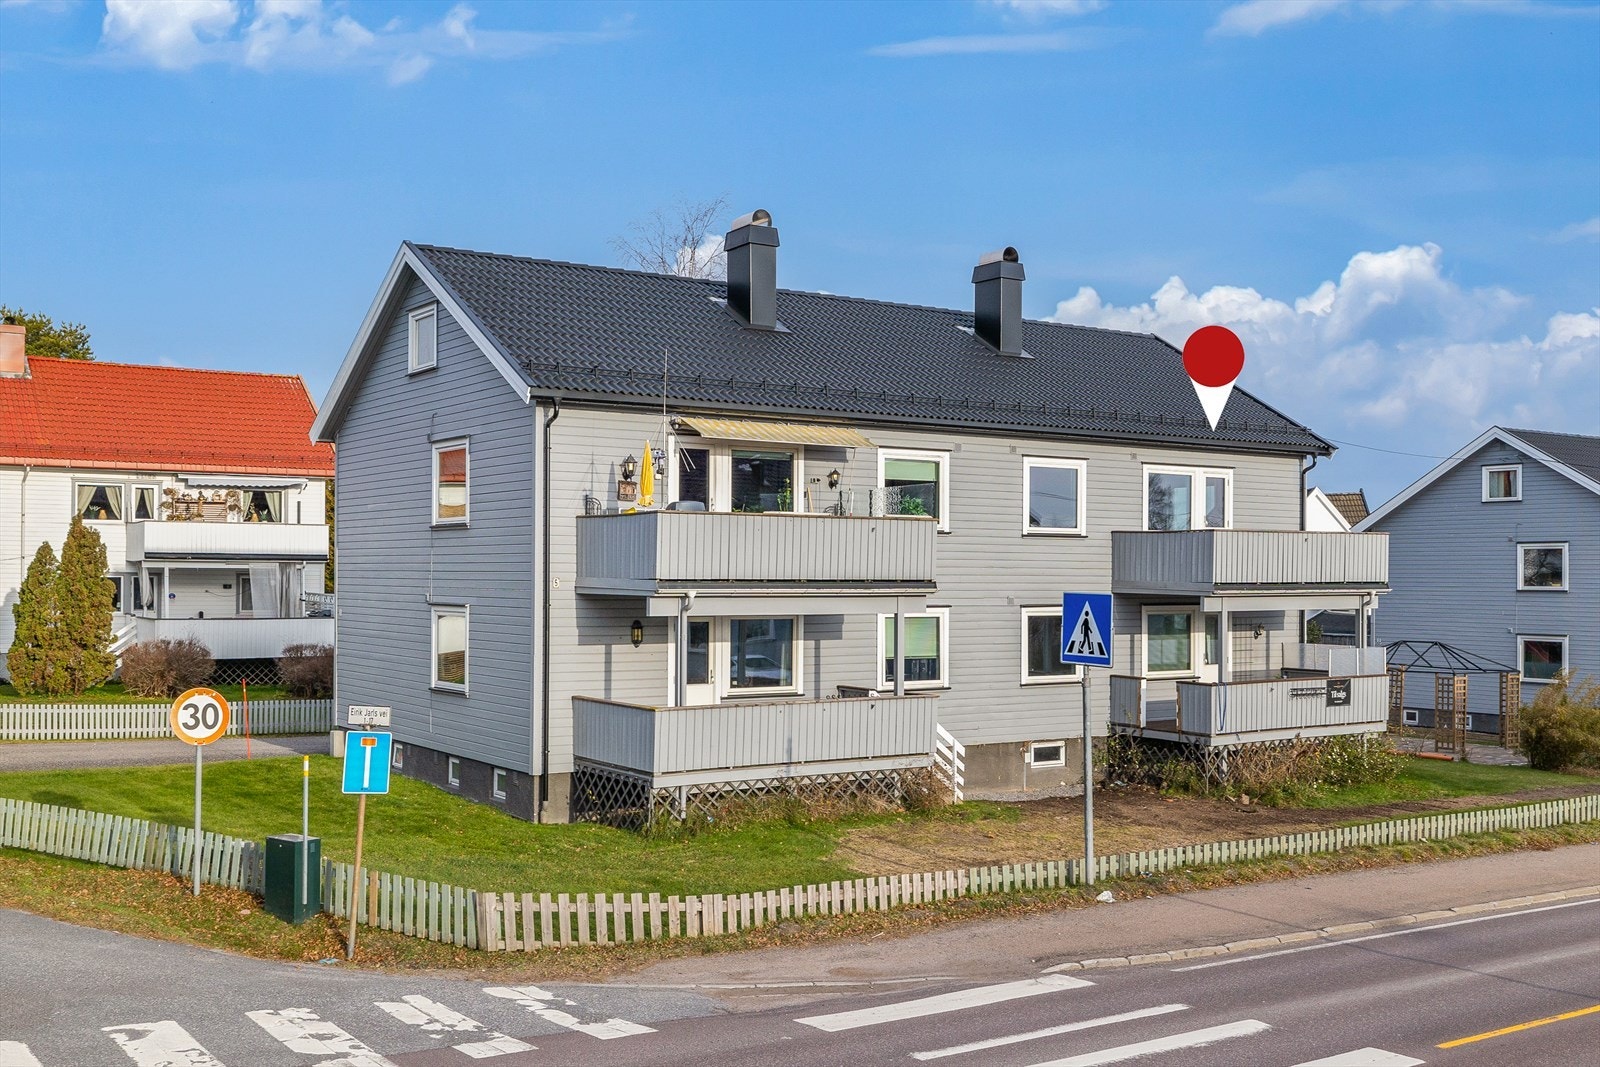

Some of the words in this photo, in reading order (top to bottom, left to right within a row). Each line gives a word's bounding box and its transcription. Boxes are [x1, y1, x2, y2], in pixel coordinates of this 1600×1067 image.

[182, 703, 219, 730] 30
[364, 709, 378, 717] Jarls
[379, 709, 388, 718] vei
